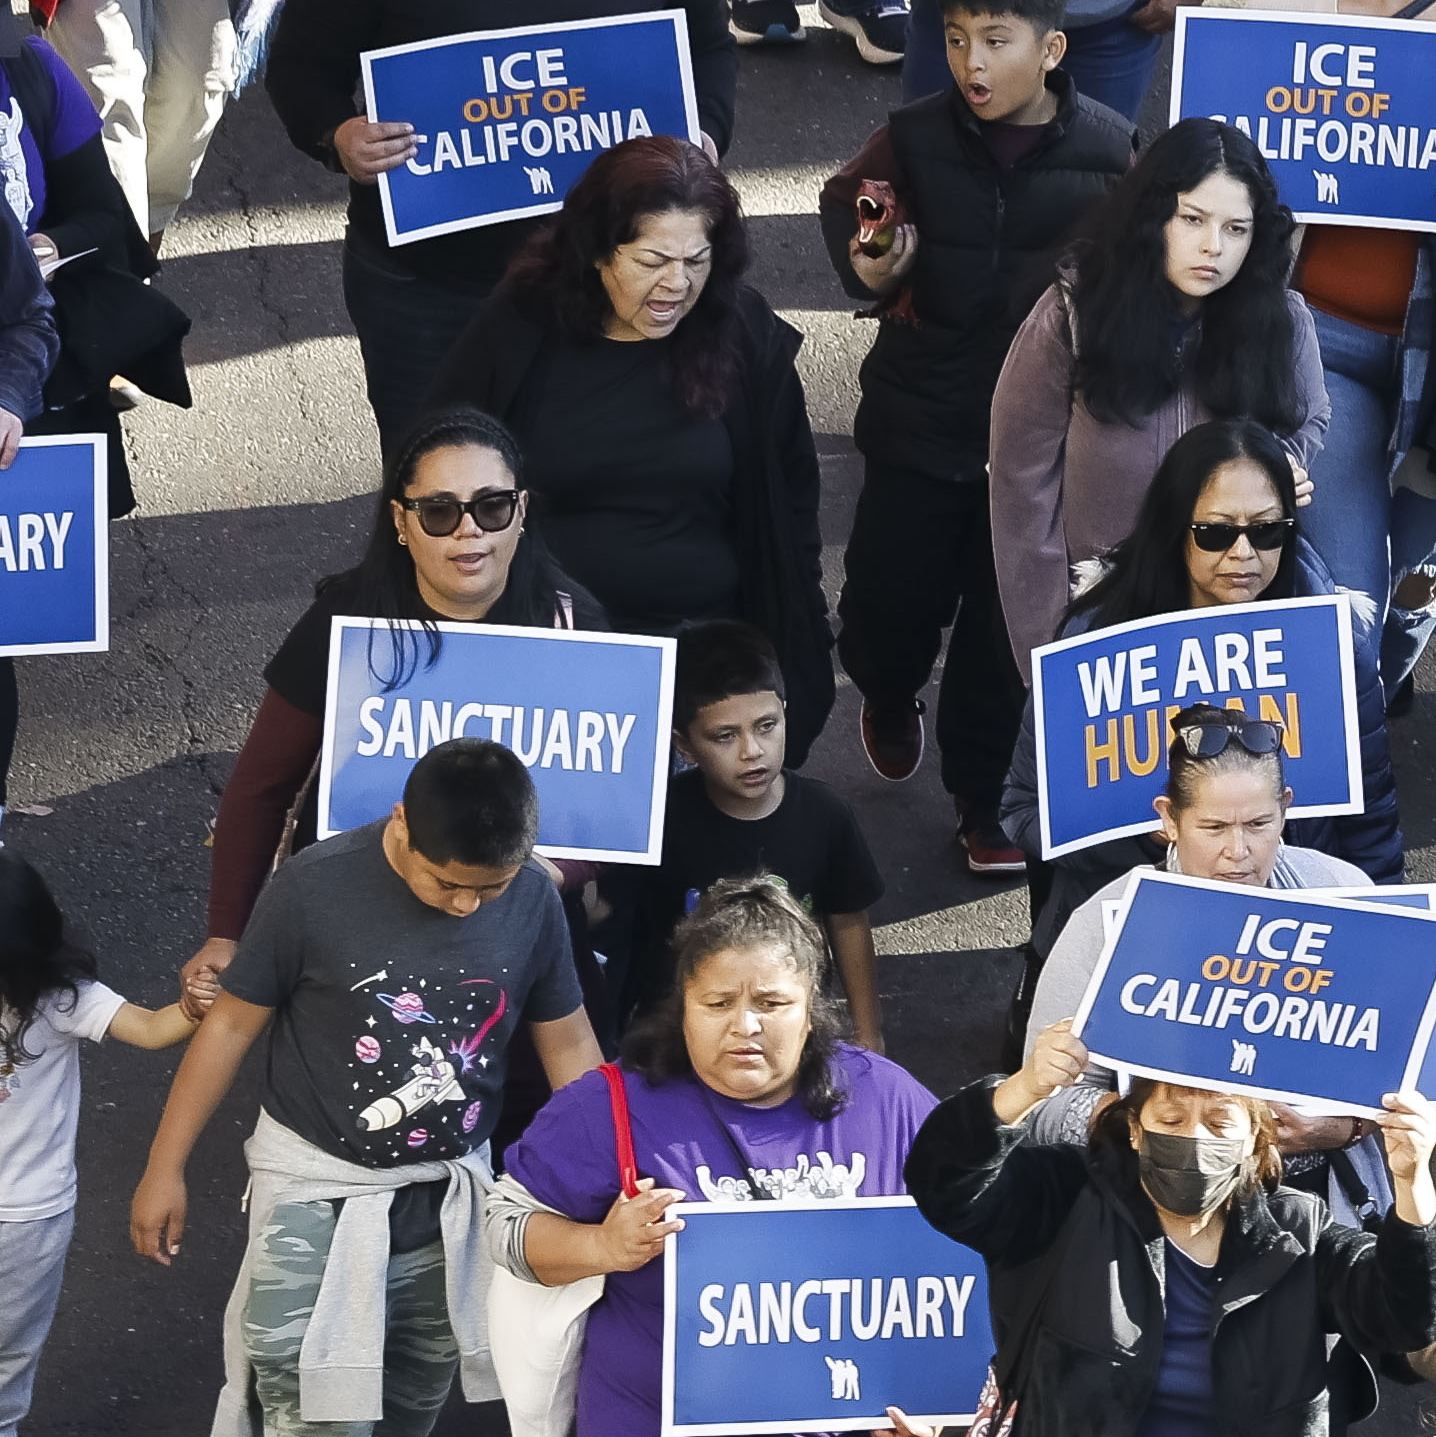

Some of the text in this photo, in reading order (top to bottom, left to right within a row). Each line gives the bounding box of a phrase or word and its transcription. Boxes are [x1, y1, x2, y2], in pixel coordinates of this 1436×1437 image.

[484, 48, 567, 92] ICE
[1294, 44, 1376, 89] ICE
[463, 87, 586, 122] OUT OF
[1266, 87, 1390, 119] OUT OF
[406, 108, 654, 177] CALIFORNIA
[1077, 628, 1287, 717] WE ARE
[1237, 914, 1333, 966] ICE
[1202, 955, 1335, 995] OUT OF
[1118, 971, 1381, 1052] CALIFORNIA
[697, 1275, 977, 1348] SANCTUARY
